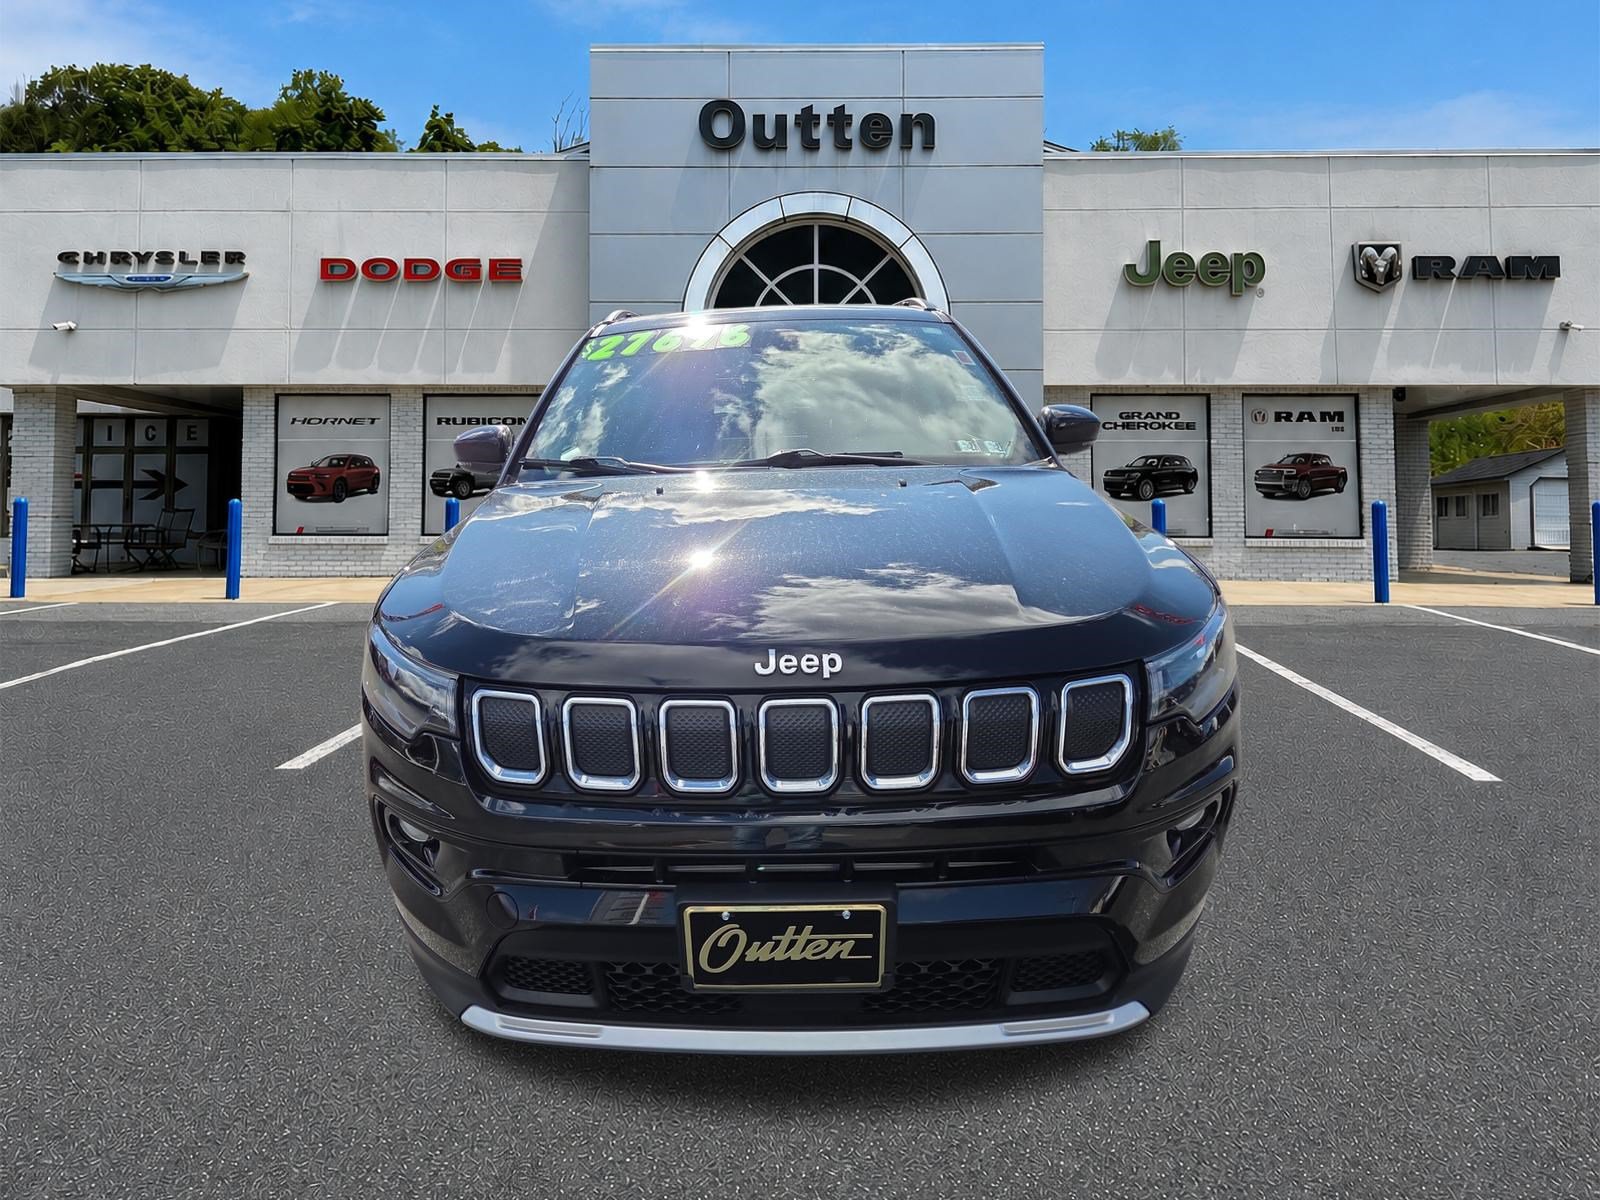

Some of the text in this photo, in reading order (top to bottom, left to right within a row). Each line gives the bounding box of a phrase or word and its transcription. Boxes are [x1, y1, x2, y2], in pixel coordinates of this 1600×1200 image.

[698, 99, 936, 150] Outten
[56, 250, 247, 266] CHRYSLER
[320, 257, 523, 282] DODGE
[1123, 239, 1266, 297] Jeep
[1411, 255, 1561, 281] RAM
[581, 323, 752, 362] $2766
[290, 417, 381, 426] HORNET
[1102, 421, 1197, 431] CHEROKEE
[1118, 411, 1181, 420] GRAND
[1274, 411, 1345, 423] RAM
[754, 648, 843, 679] Jeep
[699, 923, 874, 974] Outten
